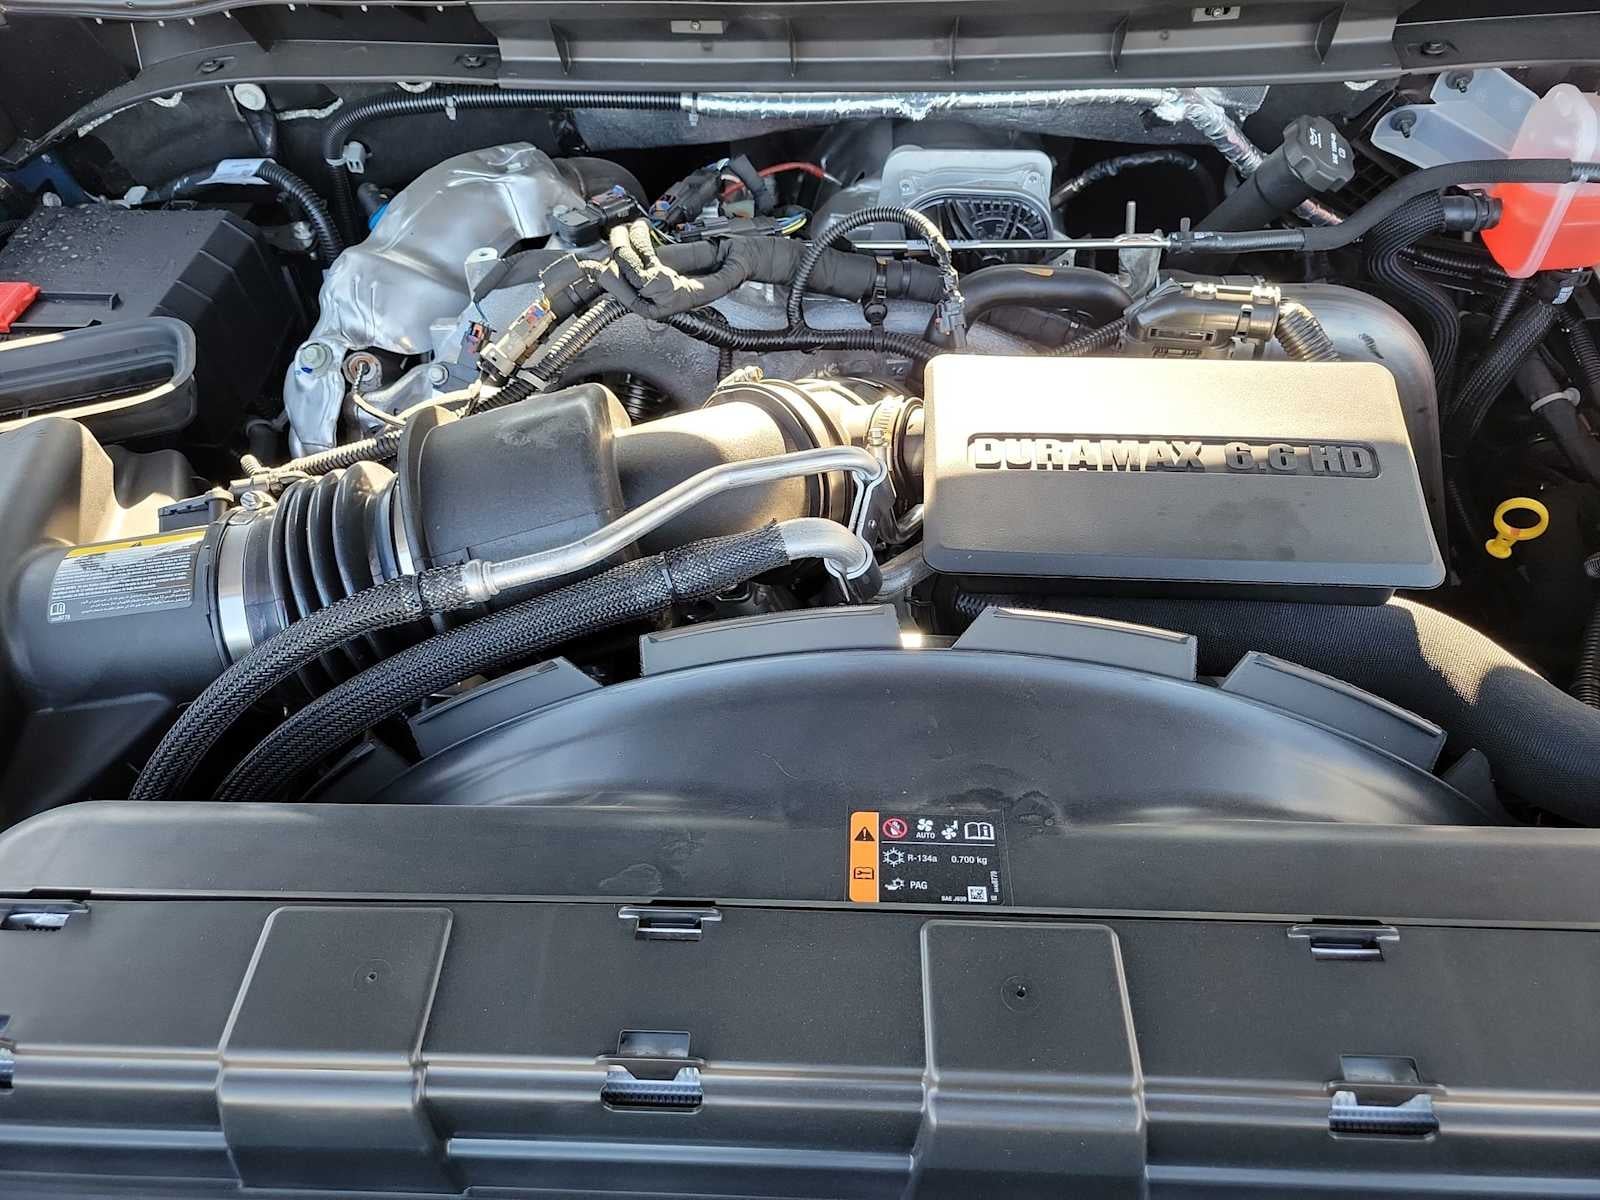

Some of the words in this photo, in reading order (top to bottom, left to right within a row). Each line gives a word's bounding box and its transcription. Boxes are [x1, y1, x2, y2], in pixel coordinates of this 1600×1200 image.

[974, 438, 1205, 472] DURAMAX
[1224, 442, 1298, 471] 6.6
[1308, 445, 1373, 473] HD
[915, 831, 936, 839] AUTO
[907, 854, 938, 863] R-134a
[950, 855, 975, 864] 0.700
[976, 856, 988, 866] kg
[909, 880, 928, 890] PAG
